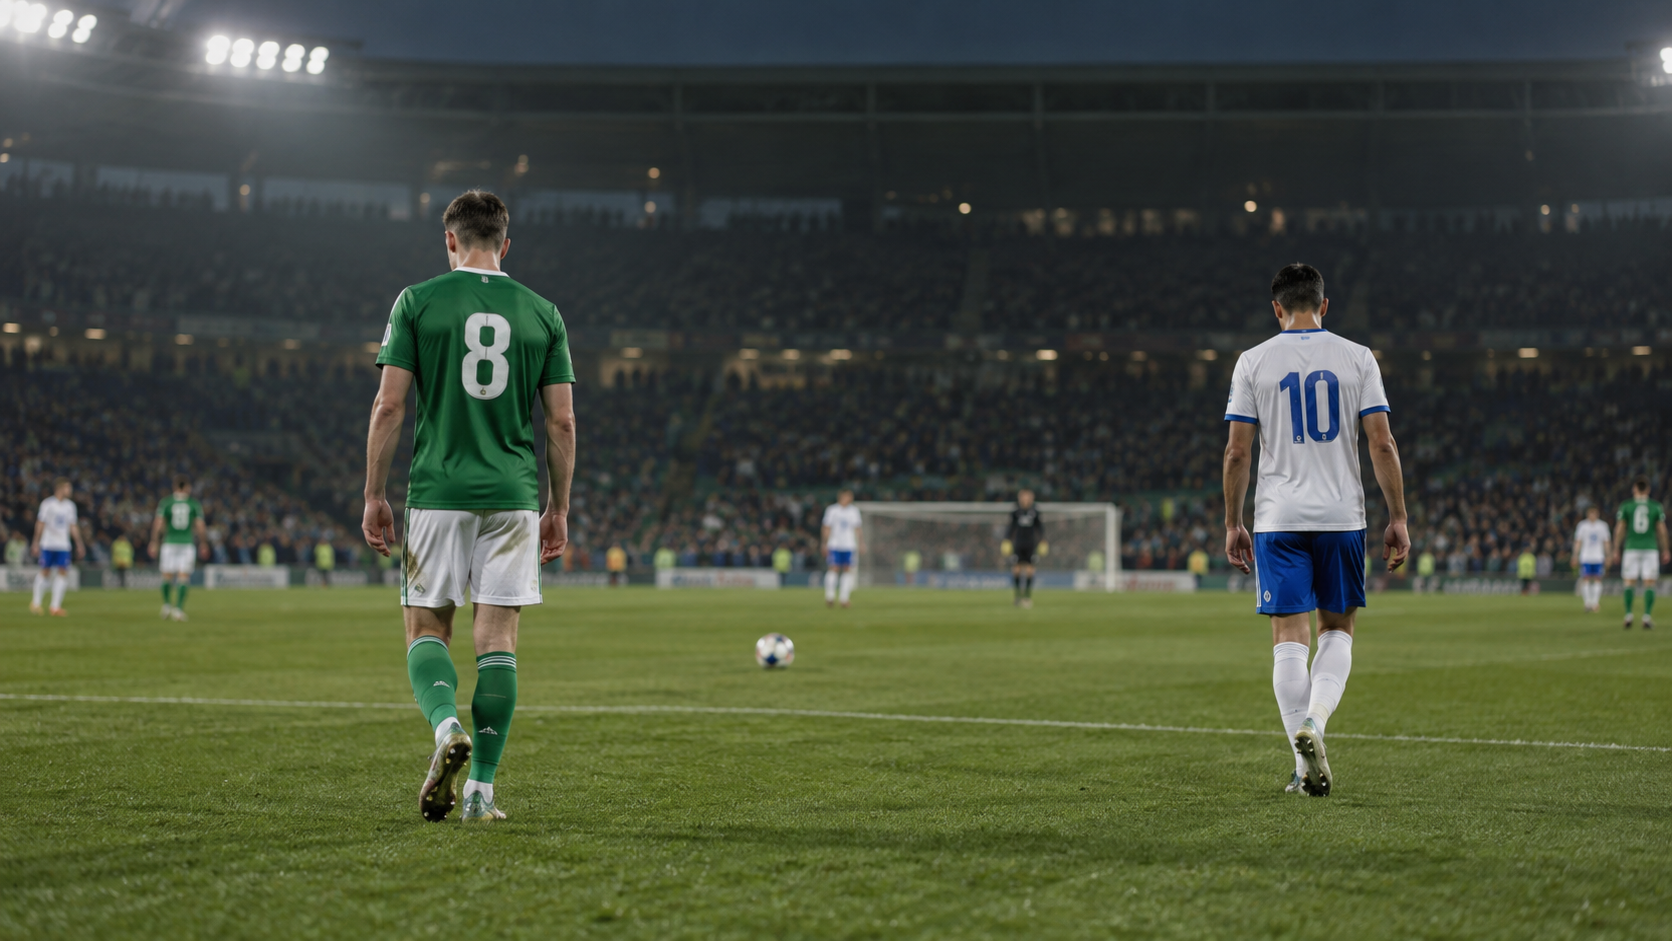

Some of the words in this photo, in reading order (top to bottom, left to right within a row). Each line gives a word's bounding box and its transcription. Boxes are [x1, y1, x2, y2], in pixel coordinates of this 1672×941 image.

[462, 312, 511, 400] 8
[1279, 370, 1340, 444] 10
[1633, 505, 1649, 534] 6
